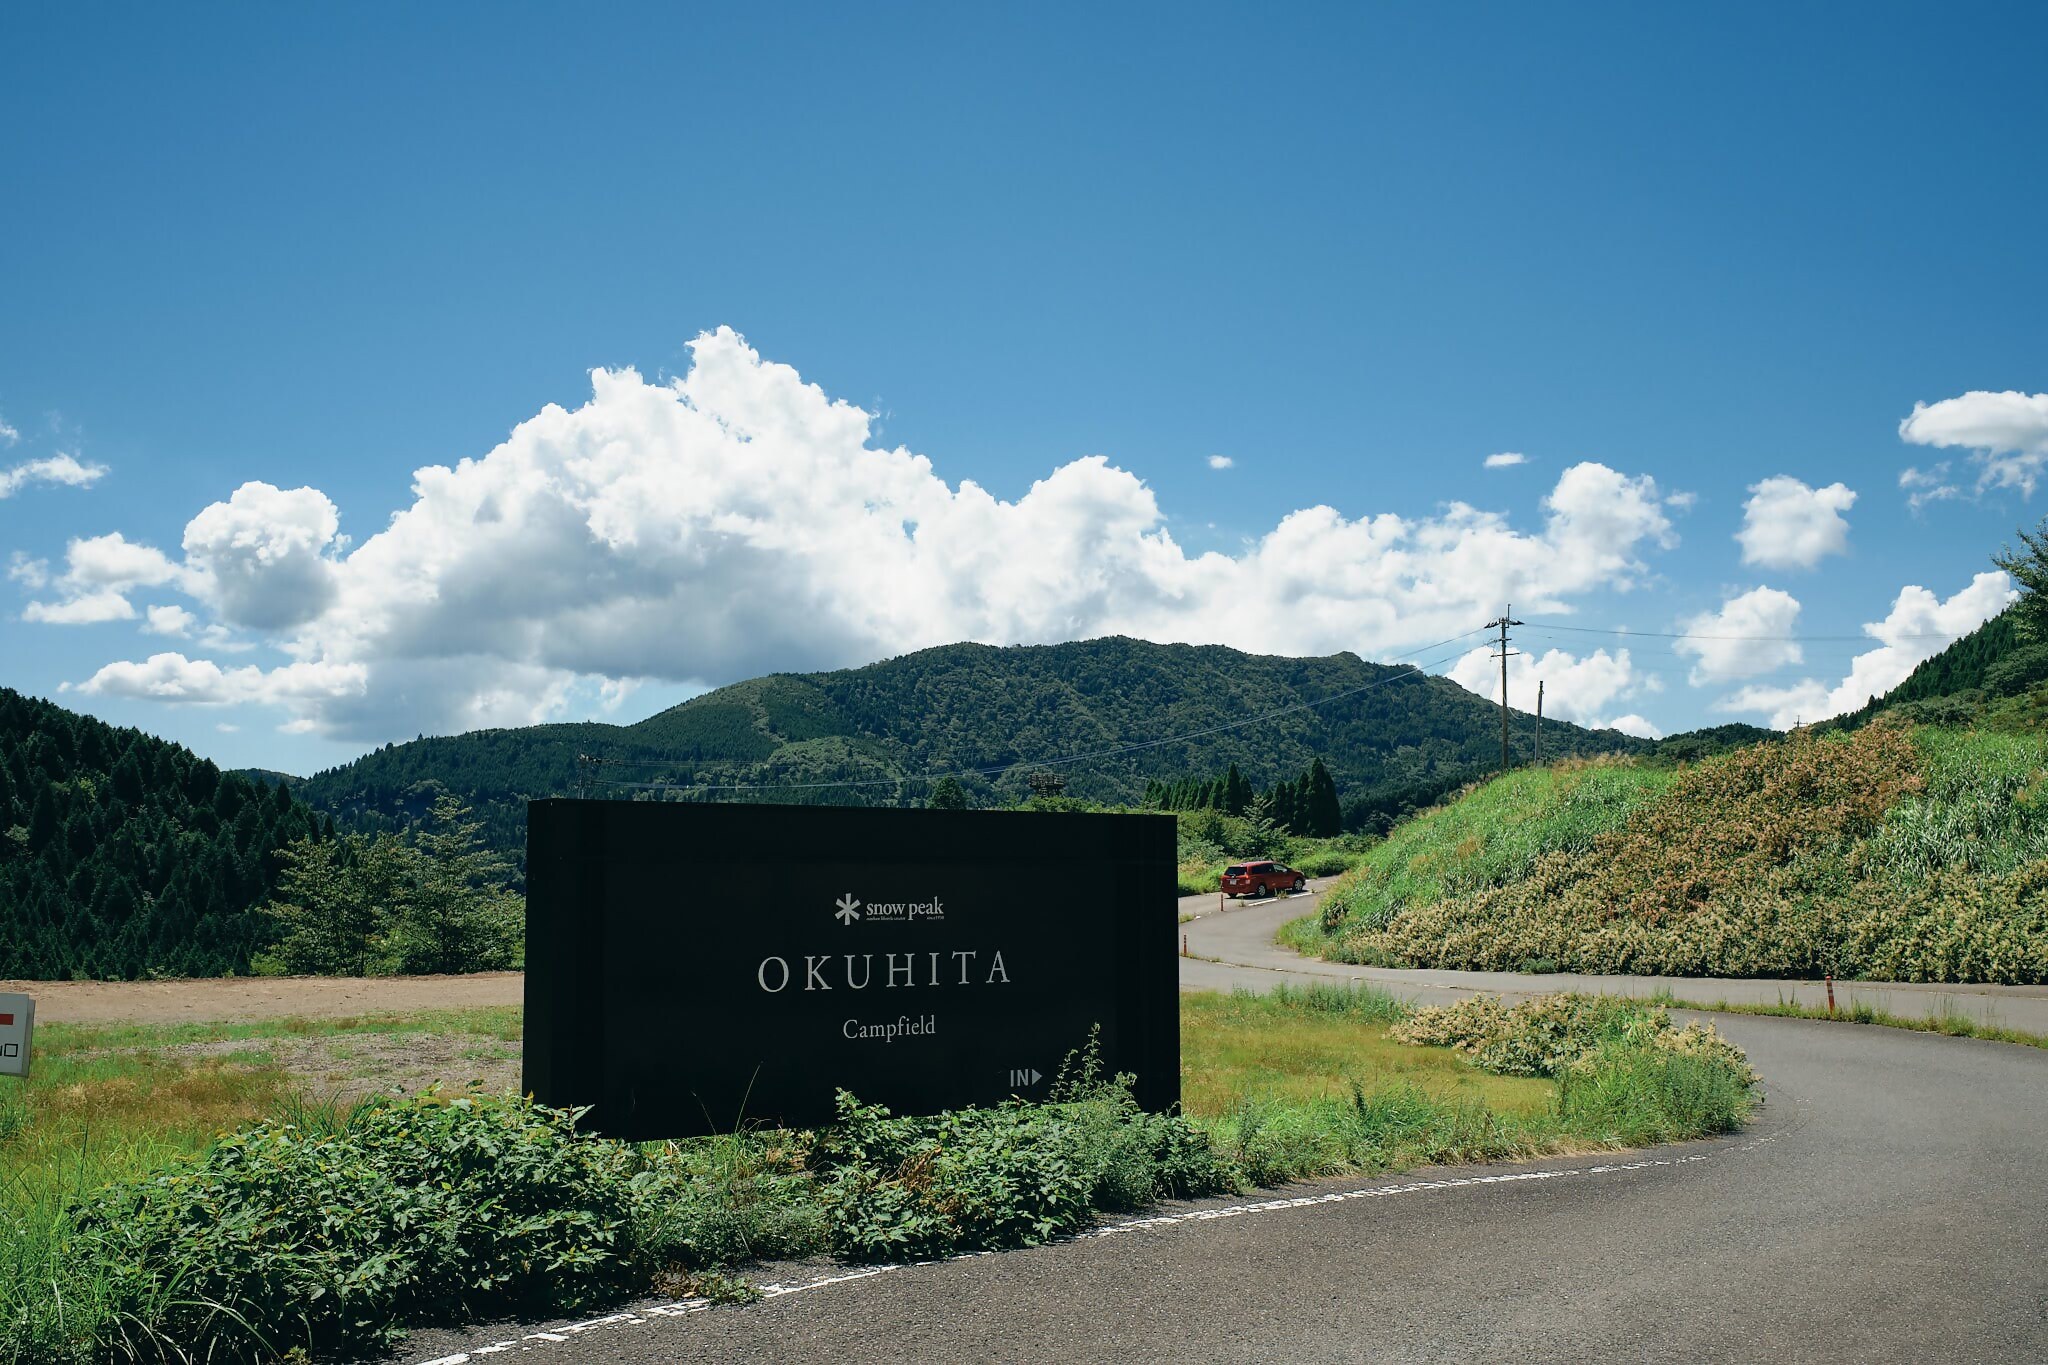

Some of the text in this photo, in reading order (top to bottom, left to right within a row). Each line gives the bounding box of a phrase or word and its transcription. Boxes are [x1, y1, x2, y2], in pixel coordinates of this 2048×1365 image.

[866, 895, 944, 921] snow peak
[757, 950, 1011, 993] OKUHITA
[843, 1014, 936, 1043] Campfield
[1010, 1068, 1029, 1088] IN
